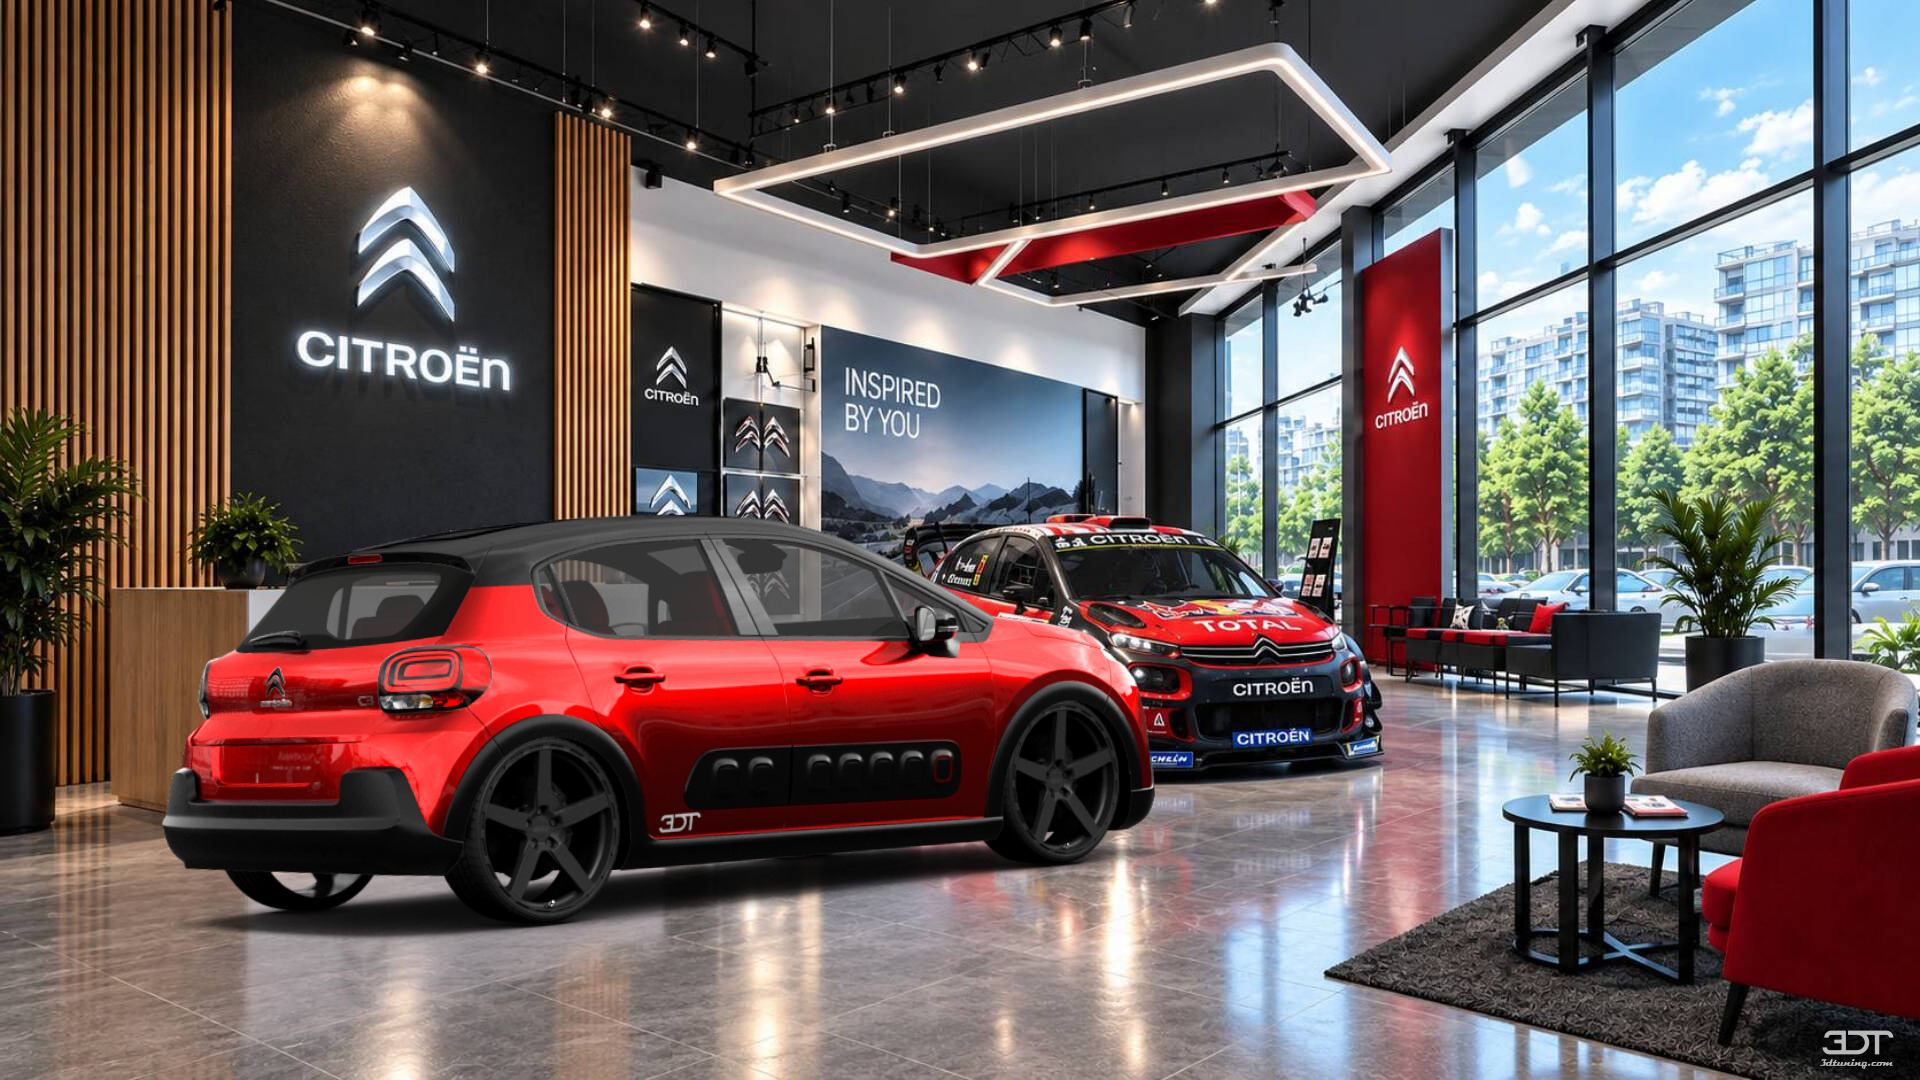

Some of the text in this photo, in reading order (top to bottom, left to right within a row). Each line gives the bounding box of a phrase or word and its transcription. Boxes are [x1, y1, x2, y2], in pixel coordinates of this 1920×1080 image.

[845, 367, 941, 409] INSPIRED
[845, 403, 920, 439] BY YOU
[1194, 619, 1302, 633] TOTAL
[659, 812, 701, 834] 3DT
